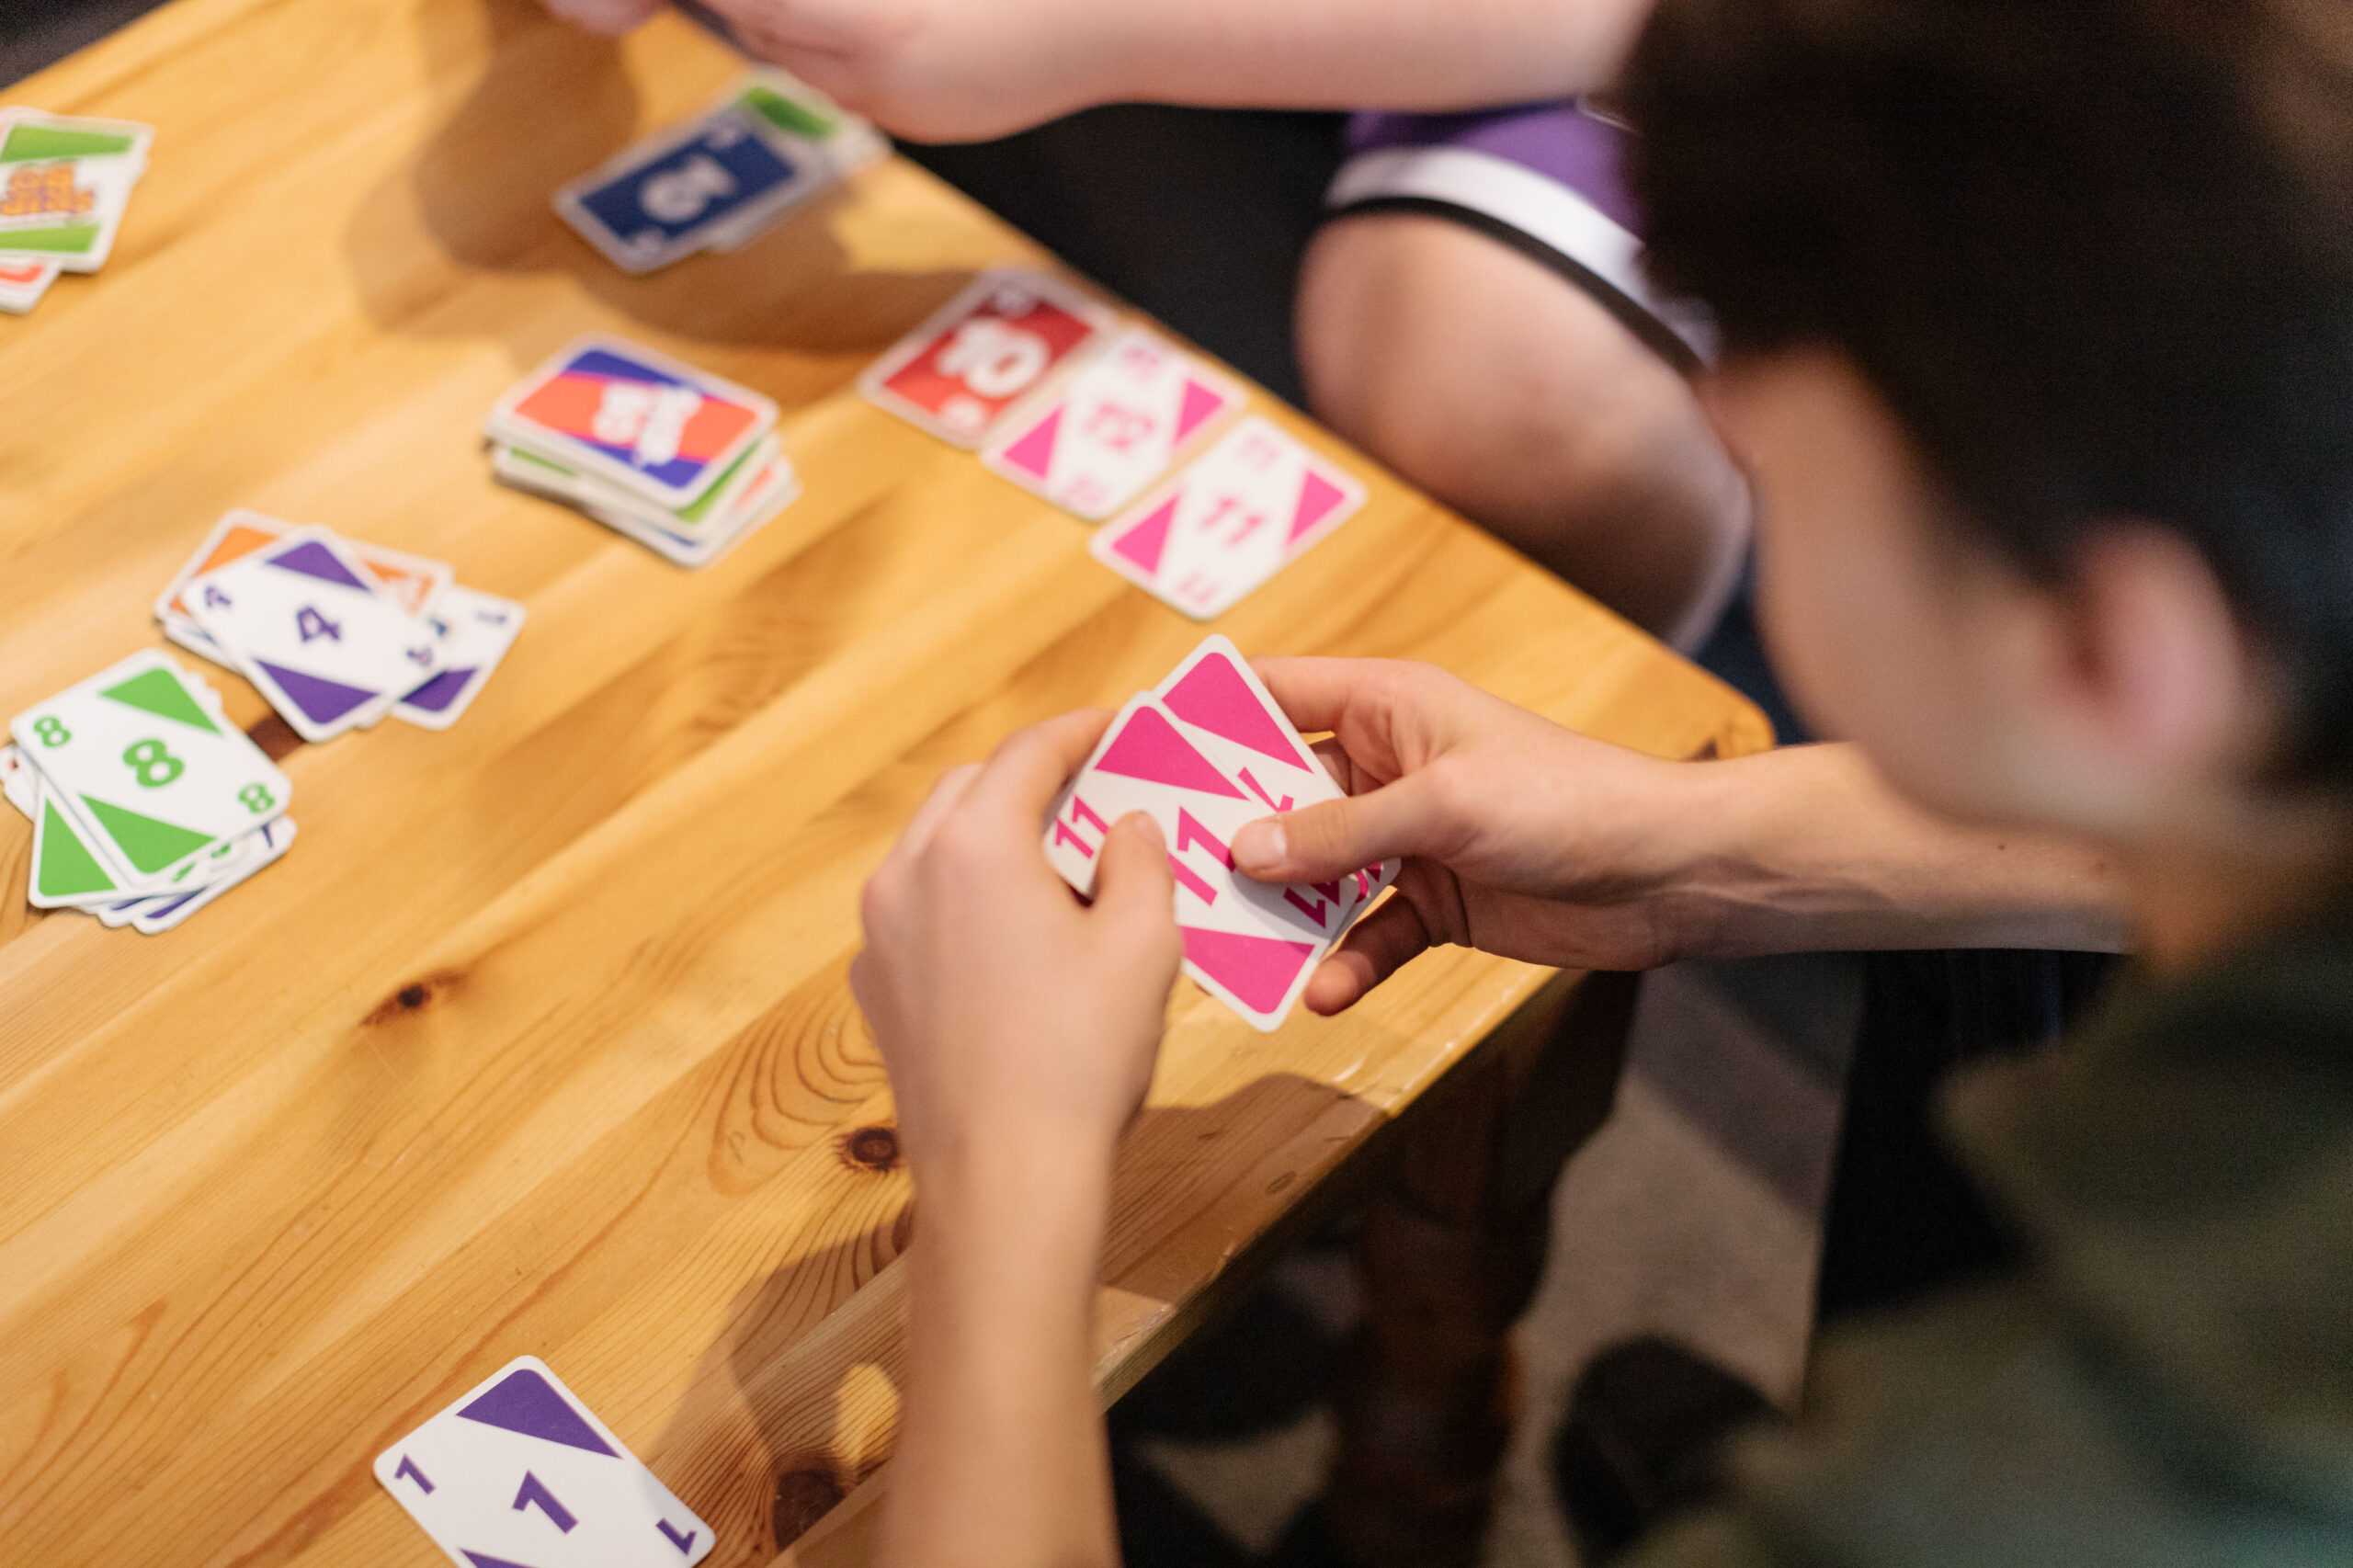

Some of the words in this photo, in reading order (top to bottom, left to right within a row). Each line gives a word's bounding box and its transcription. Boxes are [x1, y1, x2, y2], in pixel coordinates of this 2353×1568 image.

[296, 606, 341, 643] 4
[34, 715, 72, 748] 8
[122, 738, 185, 789] 8
[238, 783, 275, 813] 8
[1055, 795, 1109, 859] 11
[393, 1453, 436, 1494] 1
[512, 1470, 578, 1534] 1
[655, 1517, 697, 1555] 1
